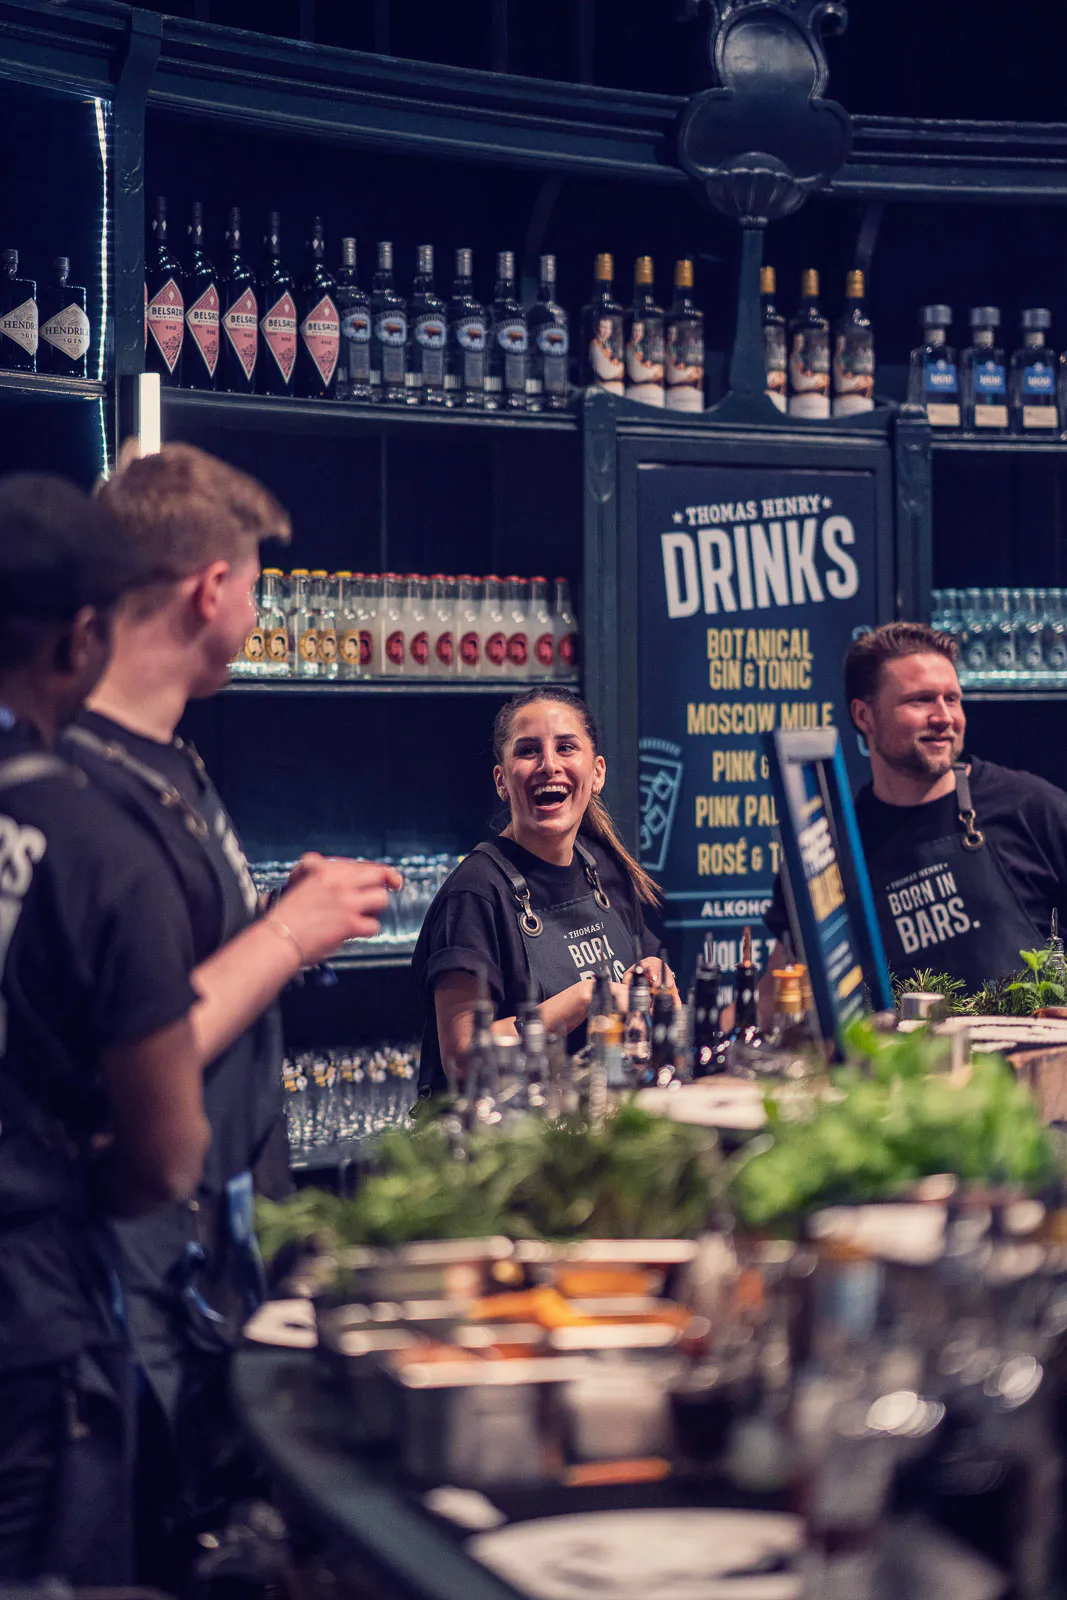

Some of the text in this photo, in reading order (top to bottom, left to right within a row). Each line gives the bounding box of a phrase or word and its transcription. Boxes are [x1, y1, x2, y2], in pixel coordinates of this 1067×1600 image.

[686, 494, 821, 526] THOMAS HENRY
[660, 515, 859, 619] DRINKS
[707, 628, 813, 660] BOTANICAL
[709, 660, 741, 690] GIN
[756, 659, 812, 690] TONIC
[687, 702, 833, 734] MOSCOW MULE
[712, 750, 756, 782] PINK
[695, 795, 739, 827] PINK
[697, 837, 748, 876] ROSÉ
[888, 871, 958, 916] BORN IN
[568, 923, 601, 940] THOMAS
[895, 896, 981, 954] BARS.
